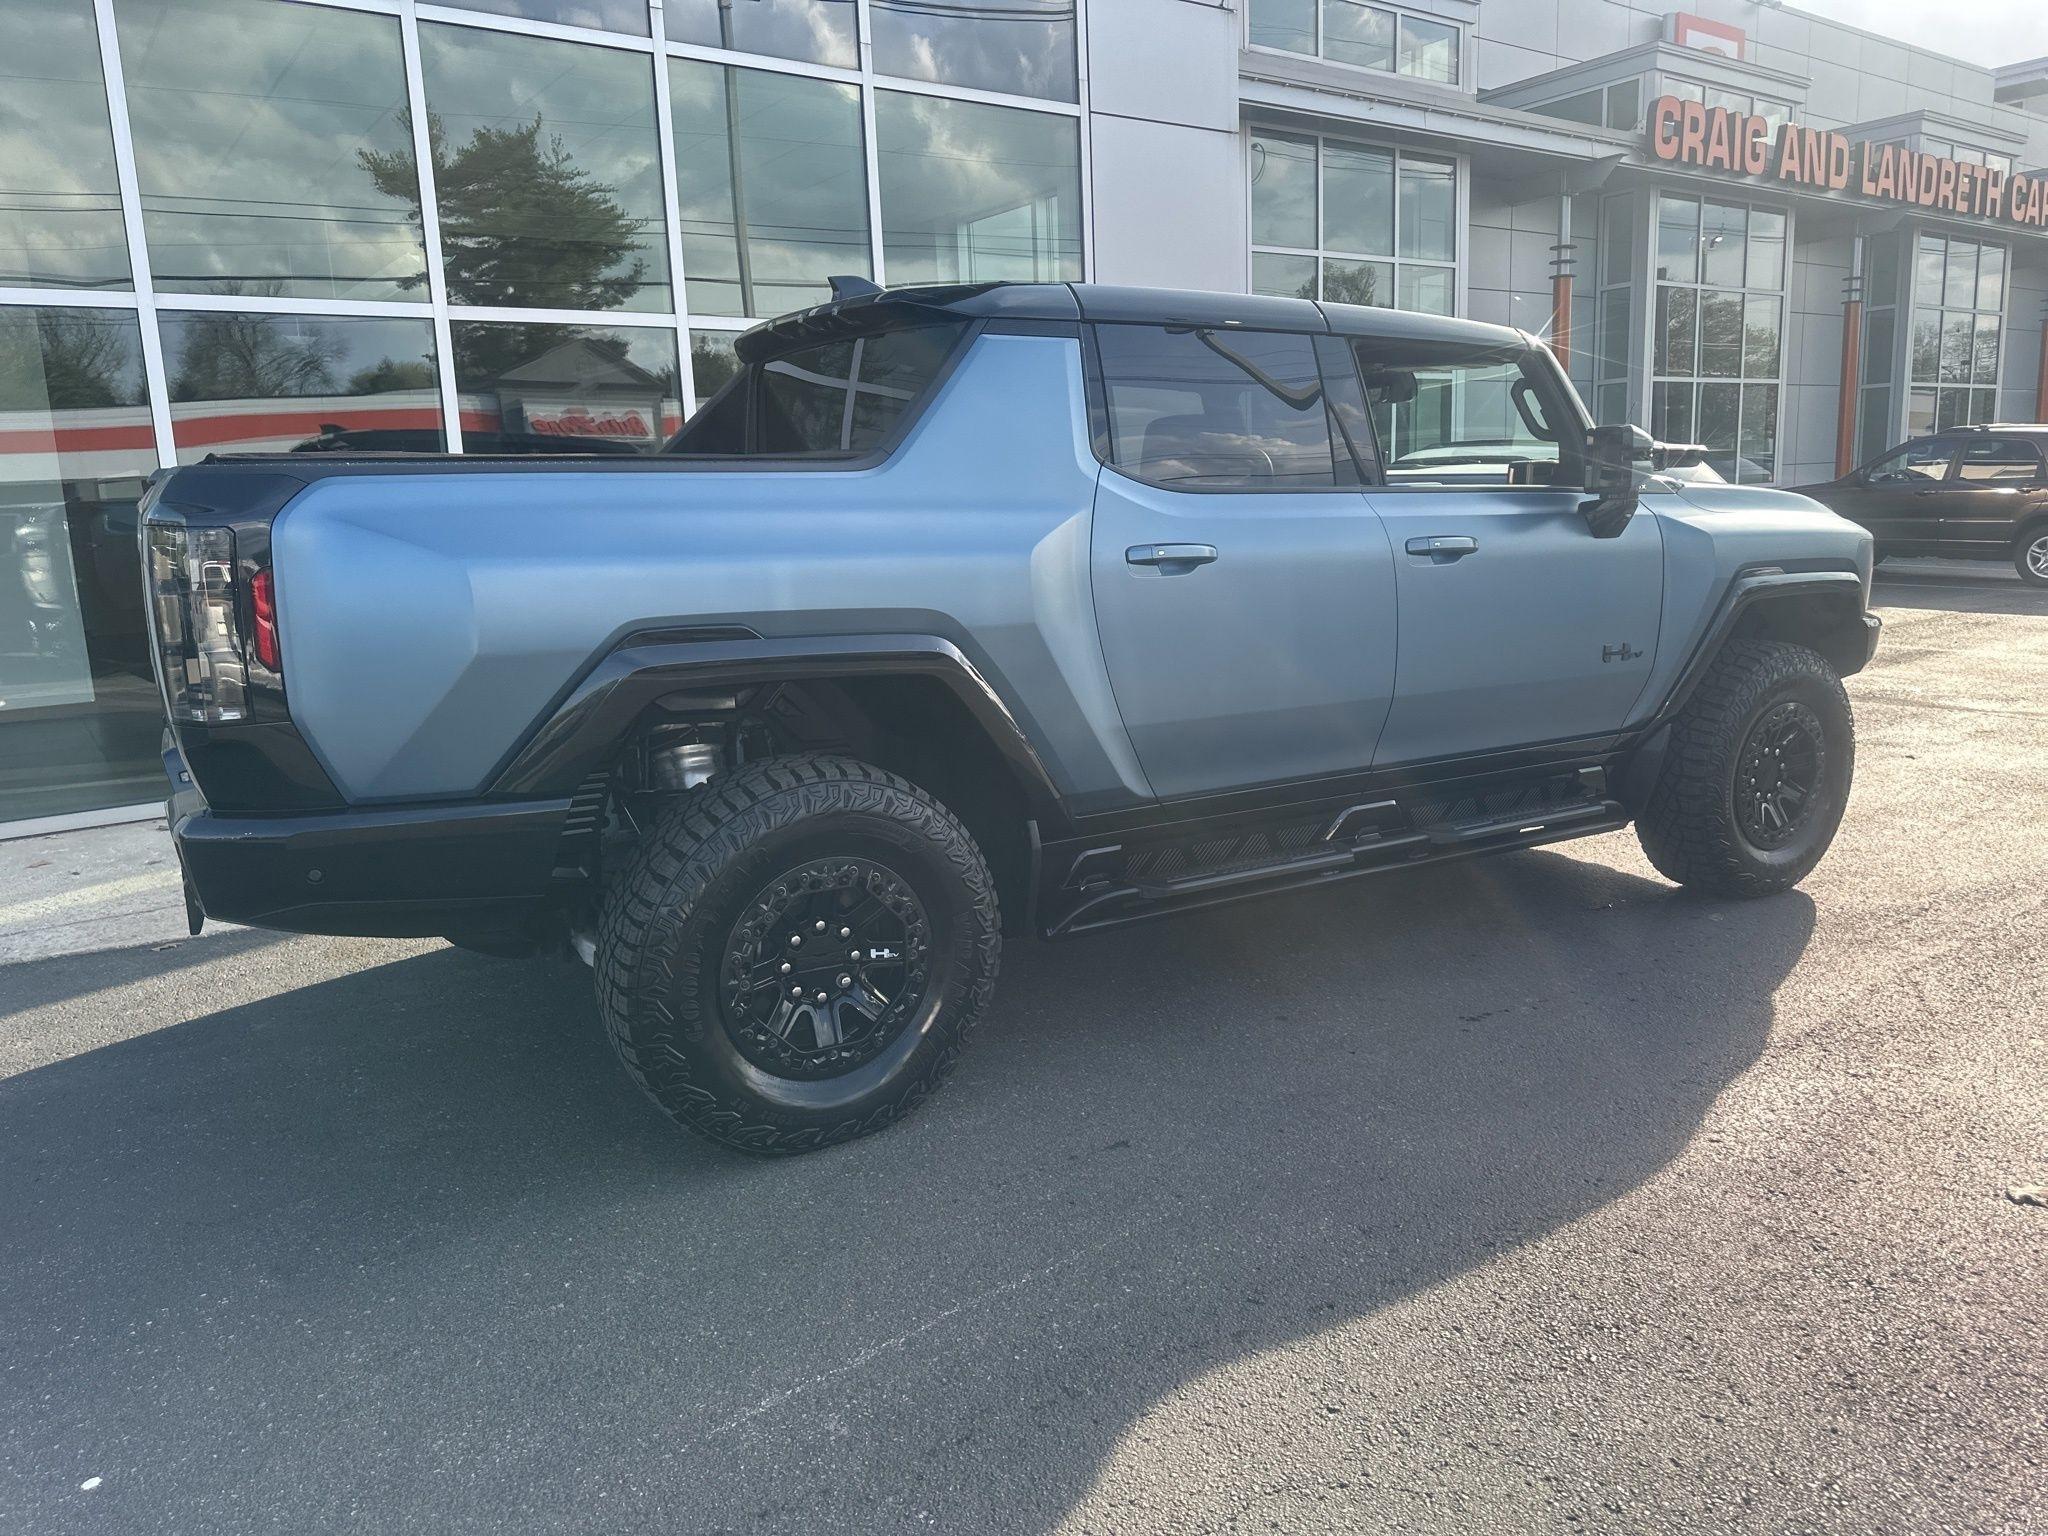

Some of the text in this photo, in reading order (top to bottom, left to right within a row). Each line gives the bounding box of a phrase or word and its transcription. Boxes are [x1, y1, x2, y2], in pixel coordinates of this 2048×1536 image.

[1653, 94, 1768, 176] CRAIG
[1779, 123, 1850, 190] AND
[1861, 138, 2004, 218] LANDRETH
